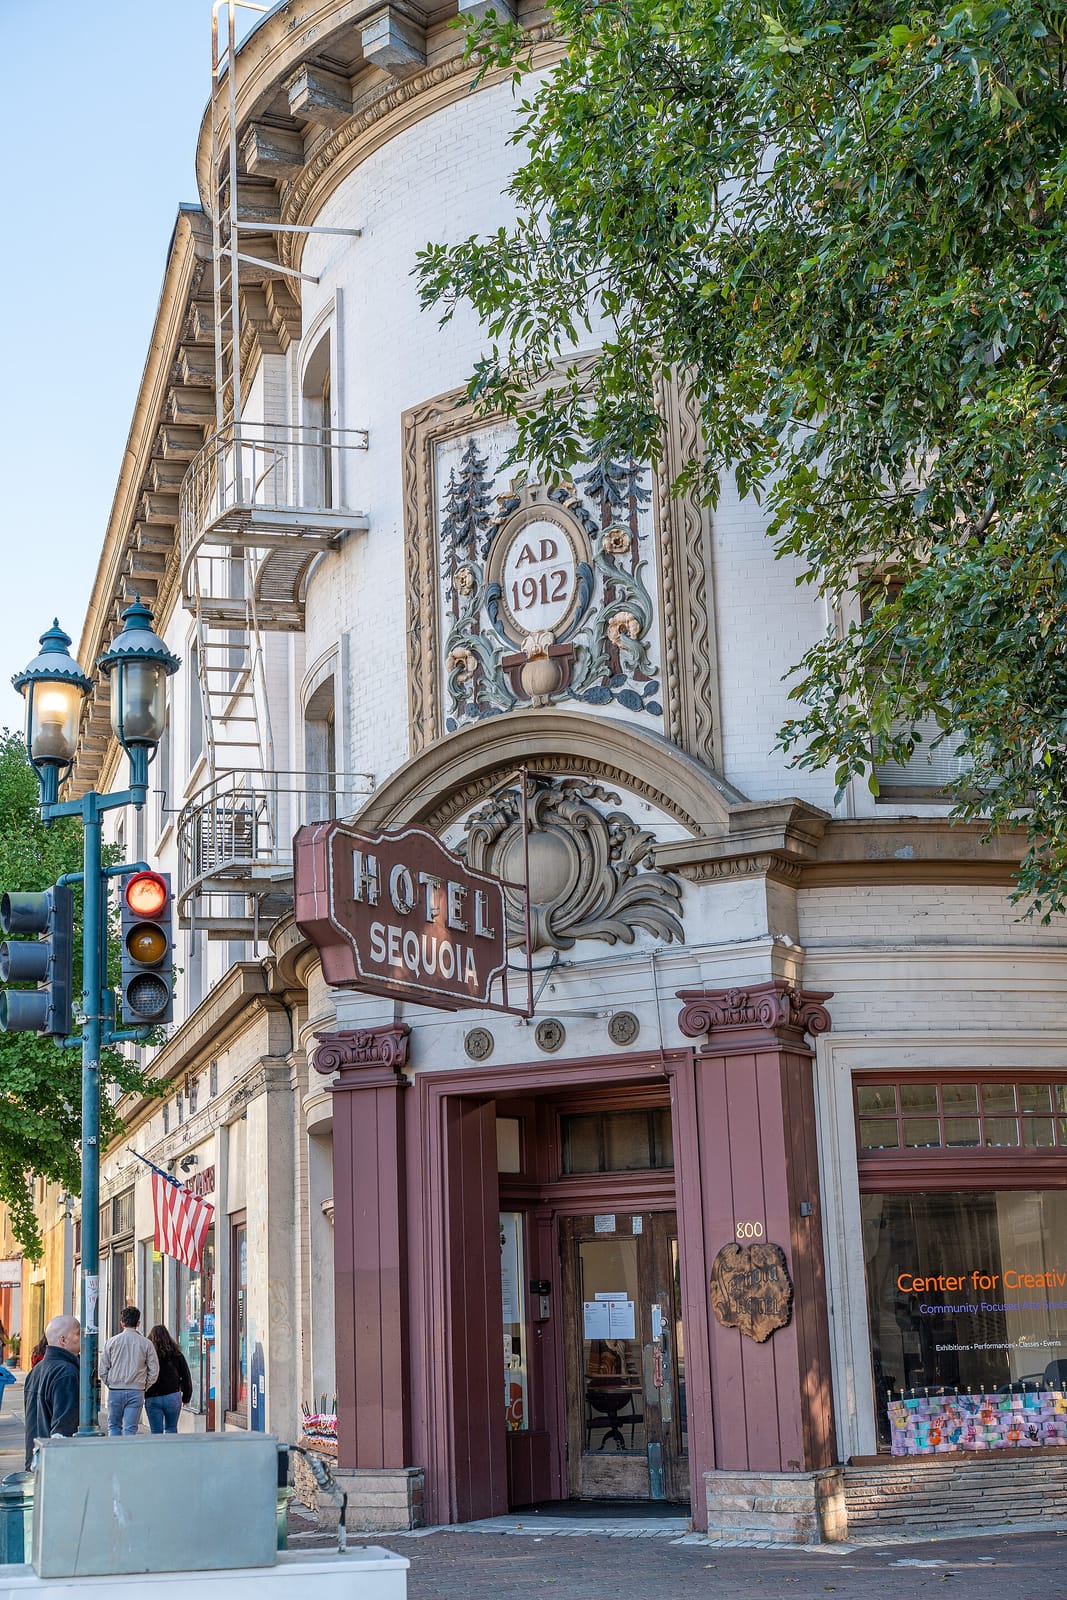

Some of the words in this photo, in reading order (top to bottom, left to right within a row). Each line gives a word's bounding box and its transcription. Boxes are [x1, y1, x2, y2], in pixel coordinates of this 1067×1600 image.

[514, 538, 559, 570] AD
[511, 569, 568, 612] 1912
[352, 849, 495, 940] HOTEL
[369, 921, 479, 987] SEQUOIA
[736, 1221, 763, 1239] 800
[897, 1272, 967, 1293] Center
[971, 1270, 1000, 1291] for
[919, 1302, 979, 1315] Community
[980, 1300, 1019, 1312] Focused
[935, 1344, 970, 1352] Exhibitions
[1042, 1340, 1062, 1348] Events
